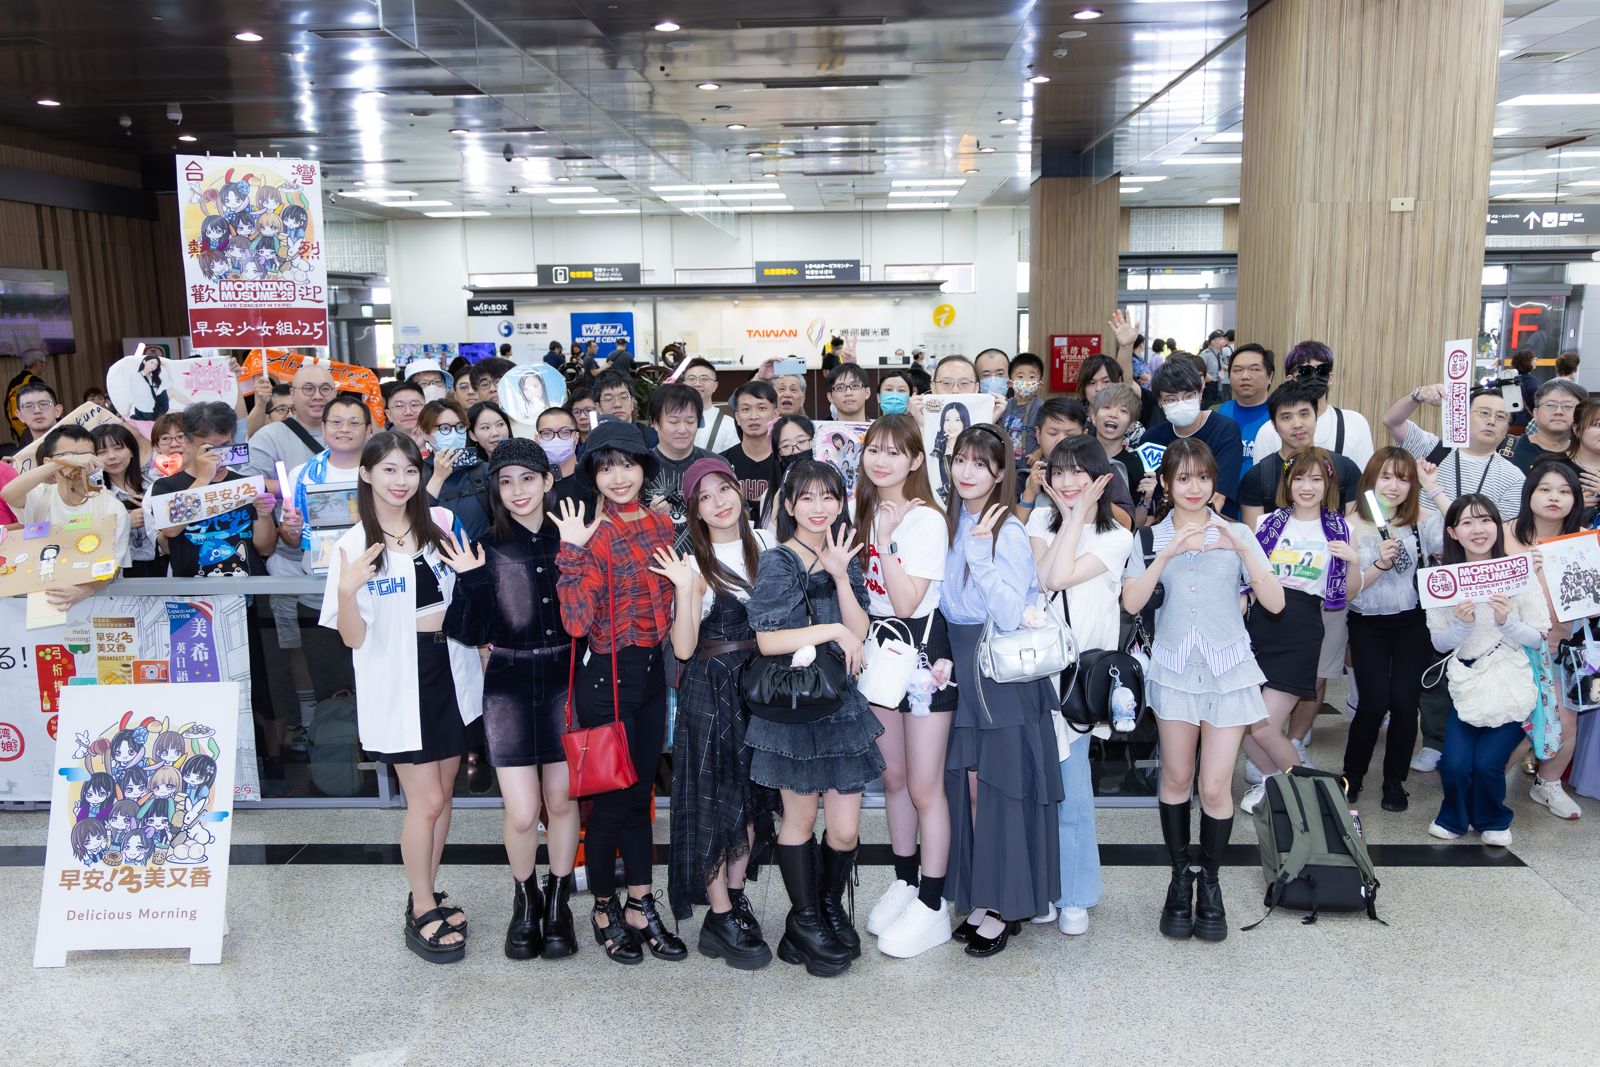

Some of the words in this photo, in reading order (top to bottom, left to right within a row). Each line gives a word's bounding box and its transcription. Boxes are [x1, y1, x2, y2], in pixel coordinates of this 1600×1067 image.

[185, 160, 204, 181] 台
[221, 281, 294, 291] MORNING
[299, 285, 324, 304] 迎
[746, 329, 798, 338] TAIWAN
[1511, 308, 1542, 349] F
[75, 406, 102, 426] kura
[1459, 557, 1527, 577] MORNING
[97, 643, 126, 652] 美又香
[190, 618, 209, 661] 美希
[1, 740, 14, 752] 娘
[66, 909, 132, 921] Delicious
[138, 907, 197, 921] Morning
